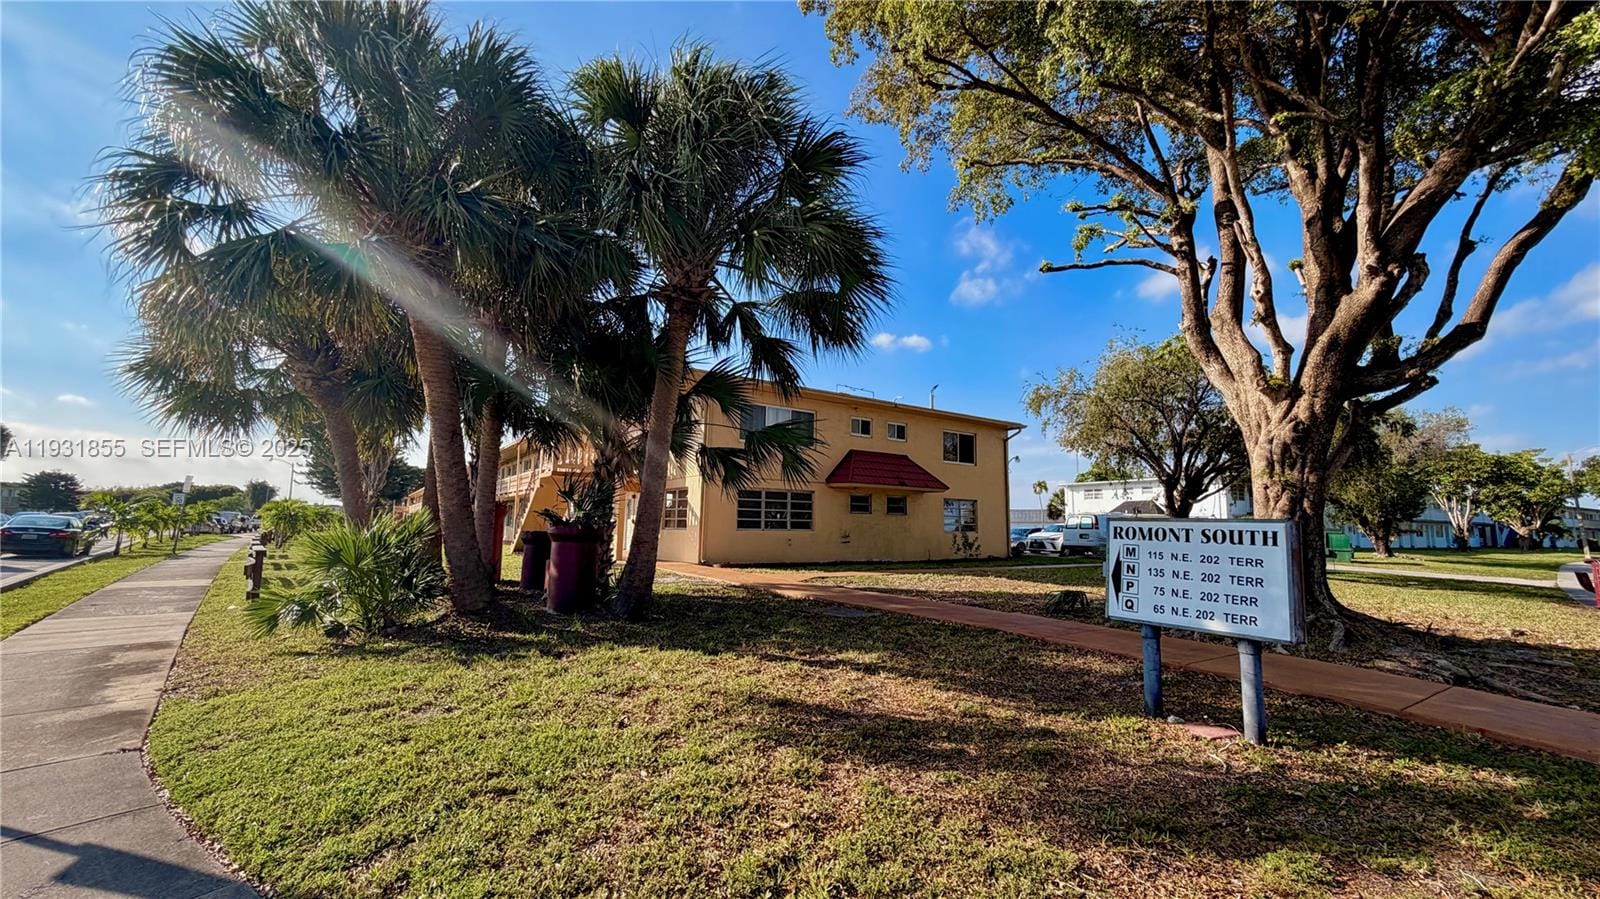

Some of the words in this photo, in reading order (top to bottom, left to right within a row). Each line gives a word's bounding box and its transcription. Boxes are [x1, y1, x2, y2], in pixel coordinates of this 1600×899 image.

[1113, 526, 1194, 543] ROMONT
[1200, 528, 1279, 547] SOUTH
[1125, 546, 1136, 558] M
[1148, 551, 1164, 560] 115
[1170, 553, 1193, 563] N.E.
[1200, 554, 1220, 565] 202
[1228, 556, 1264, 568] TERR
[1126, 564, 1135, 575] N
[1148, 568, 1165, 578] 135
[1172, 570, 1194, 581] N.E.
[1200, 572, 1220, 584] 202
[1229, 575, 1264, 588] TERR
[1126, 581, 1134, 592] P
[1153, 586, 1165, 596] 75
[1171, 588, 1193, 600] N.E.
[1200, 592, 1220, 603] 202
[1224, 594, 1259, 607] TERR
[1125, 599, 1134, 610] Q
[1153, 605, 1165, 614] 65
[1171, 607, 1192, 618] N.E.
[1195, 610, 1215, 621] 202
[1223, 612, 1258, 626] TERR
